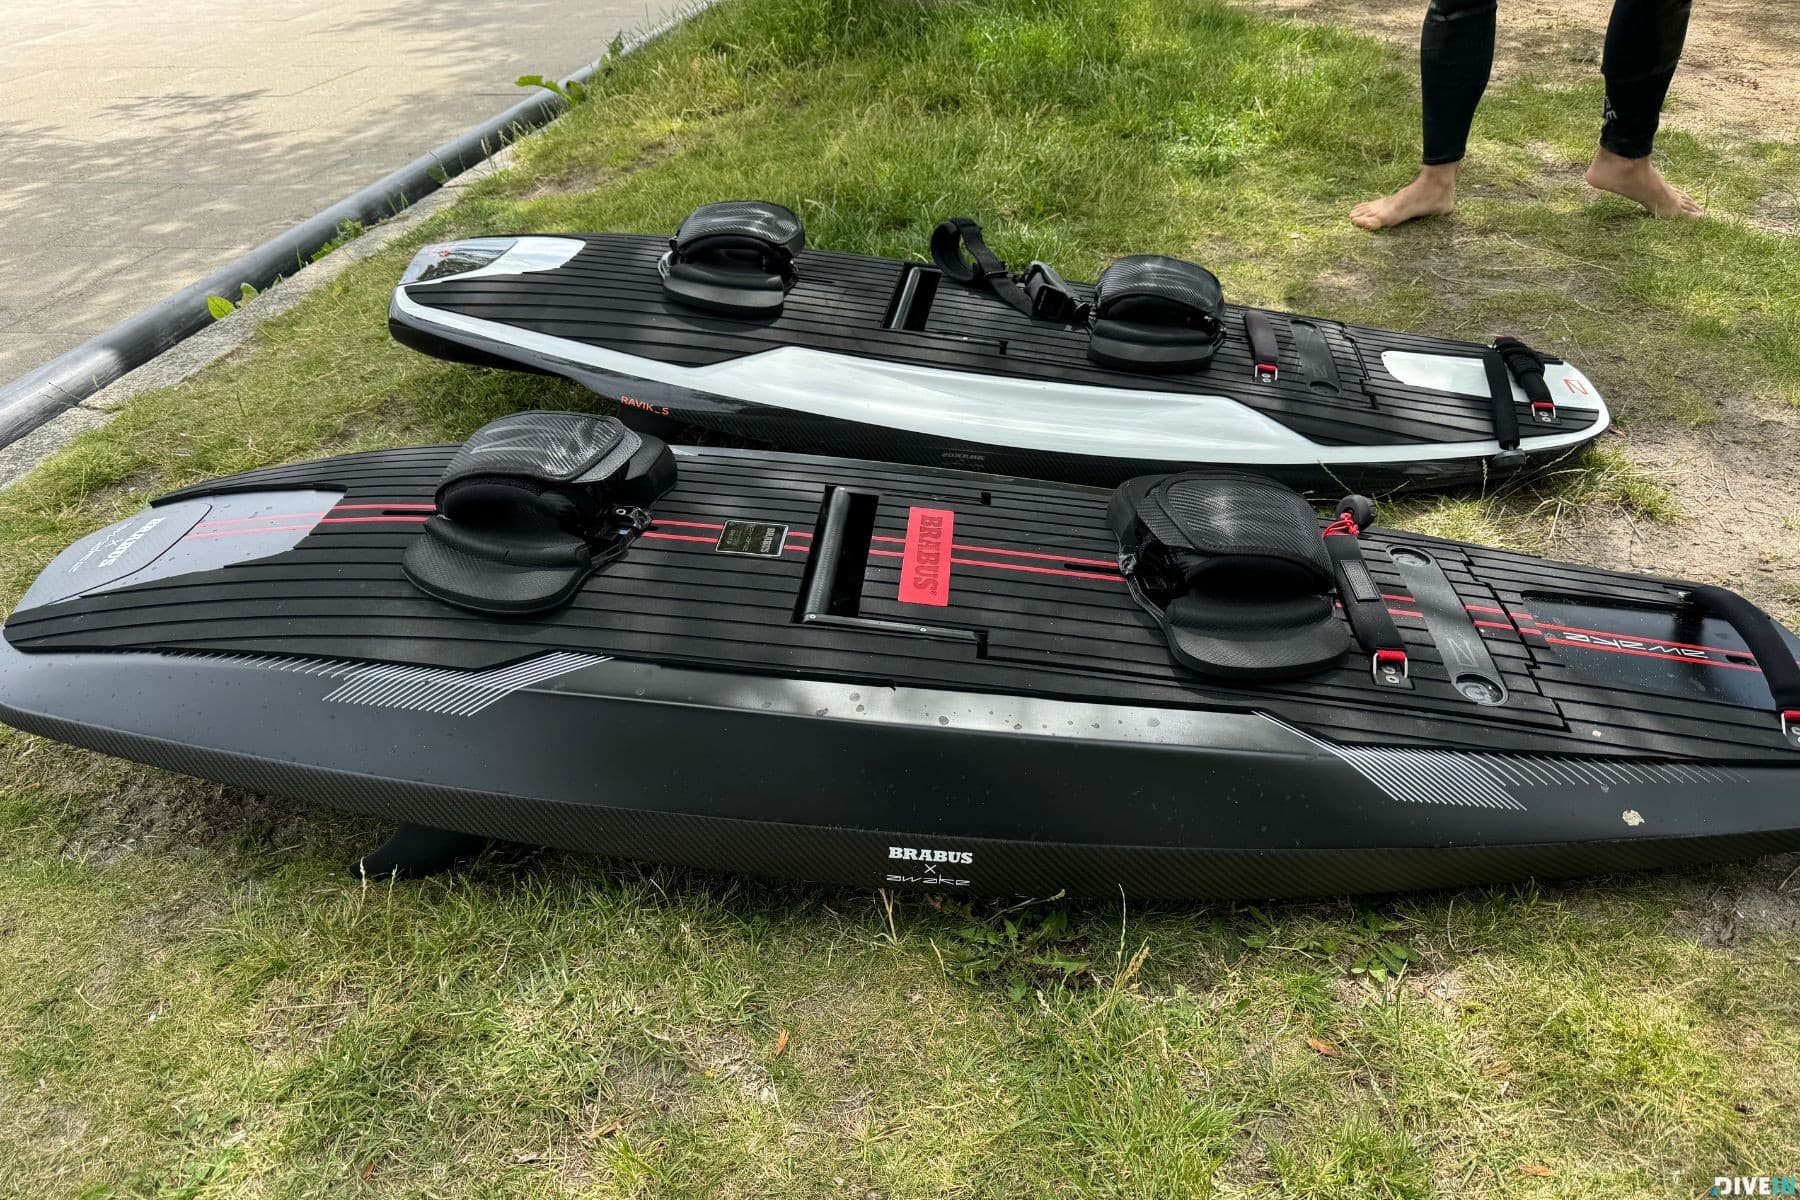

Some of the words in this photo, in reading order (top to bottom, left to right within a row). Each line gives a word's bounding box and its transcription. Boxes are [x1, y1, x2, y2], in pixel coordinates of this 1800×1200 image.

[98, 517, 168, 567] BRABUS
[1563, 631, 1709, 659] awake
[888, 846, 974, 864] BRABUS
[886, 873, 971, 887] awake
